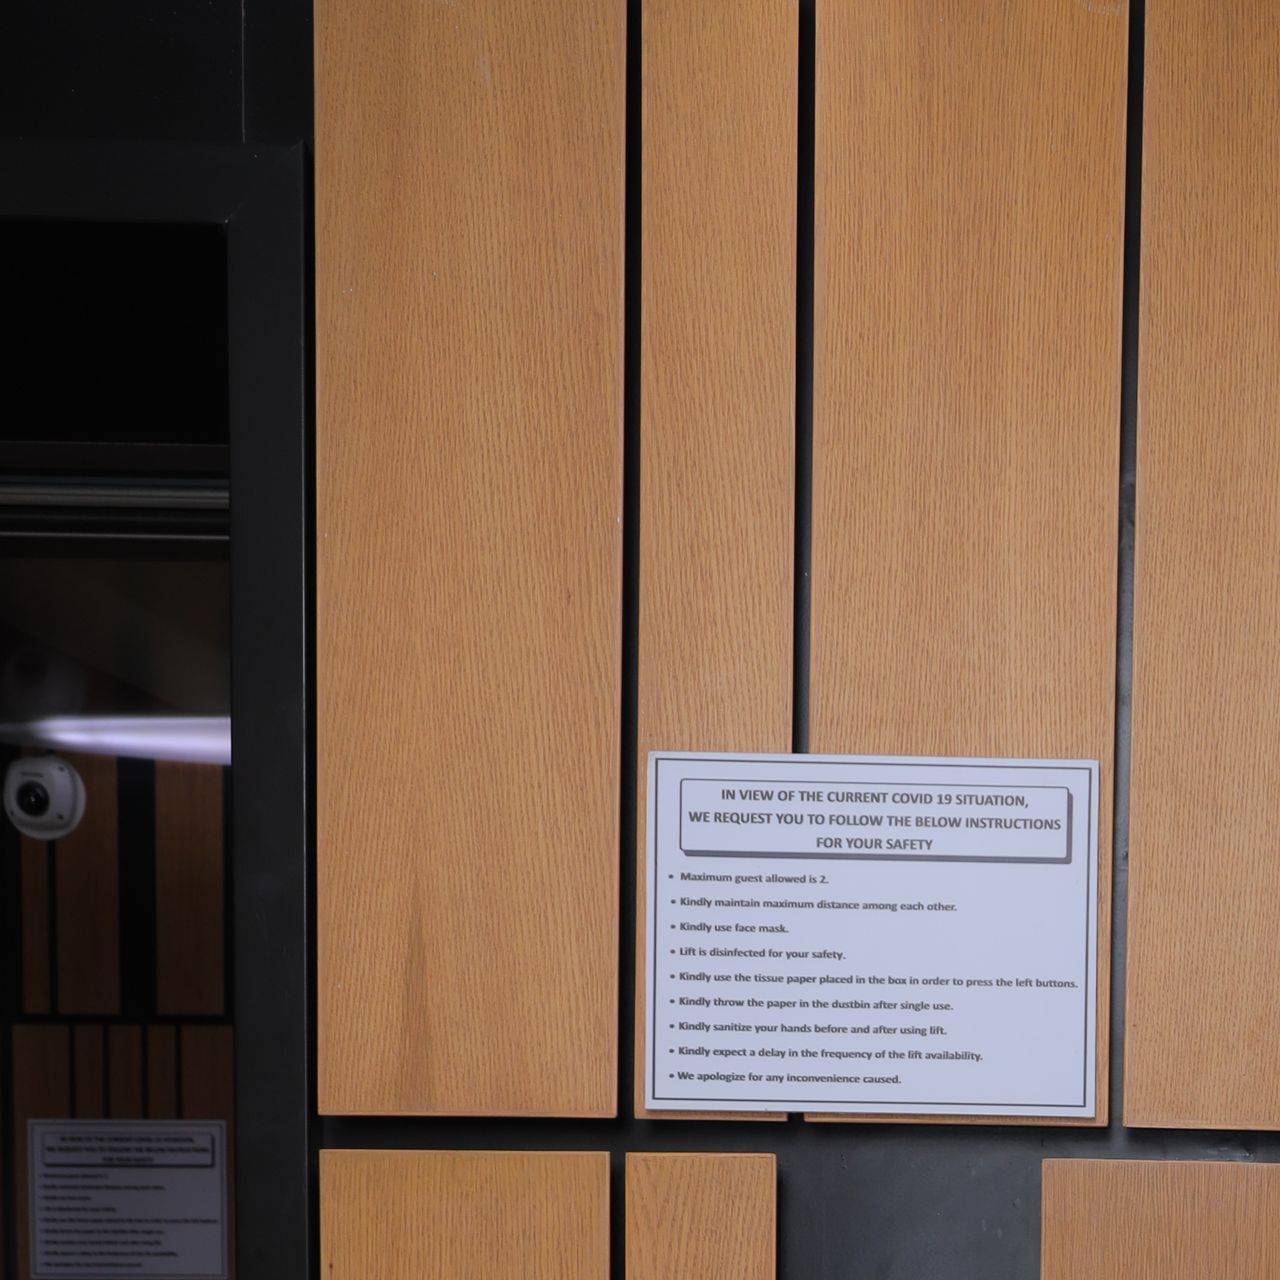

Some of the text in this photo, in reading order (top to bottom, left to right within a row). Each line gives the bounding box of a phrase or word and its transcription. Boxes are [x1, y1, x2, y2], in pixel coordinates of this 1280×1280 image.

[721, 789, 1028, 808] IN VIEW OF THE CURRENT COVID 19 SITUATION,
[688, 811, 1061, 830] WE REQUEST YOU TO FOLLOW THE BELOW INSTRUCTIONS
[816, 836, 933, 850] FOR YOUR SAFETY
[680, 872, 829, 885] Maximum guest allowed is 2.
[680, 896, 957, 912] Kindly maintain maximum distance among each other.
[679, 922, 712, 933] Kindly
[734, 923, 756, 932] face
[758, 923, 788, 933] mask.
[679, 947, 846, 961] Lift is disinfected for your safety.
[679, 971, 1078, 988] Kindly use the tissue paper placed in the box in order to press the left buttons.
[678, 996, 711, 1008] Kindly
[713, 997, 744, 1007] throw
[746, 997, 764, 1007] the
[766, 1000, 797, 1009] paper
[799, 999, 809, 1008] in
[811, 999, 829, 1008] the
[831, 999, 870, 1009] dustbin
[872, 1000, 897, 1009] after
[900, 1000, 930, 1012] single
[678, 1021, 946, 1036] Kindly sanitize your hands before and after using lift.
[678, 1046, 710, 1057] Kindly
[712, 1048, 747, 1058] expect
[758, 1047, 786, 1059] delay
[788, 1049, 798, 1057] in
[800, 1048, 818, 1058] the
[820, 1048, 872, 1060] frequency
[874, 1049, 885, 1059] of
[888, 1050, 905, 1059] the
[907, 1050, 922, 1059] lift
[924, 1050, 983, 1062] availability.
[677, 1071, 901, 1084] We apologize for any inconvenience caused.
